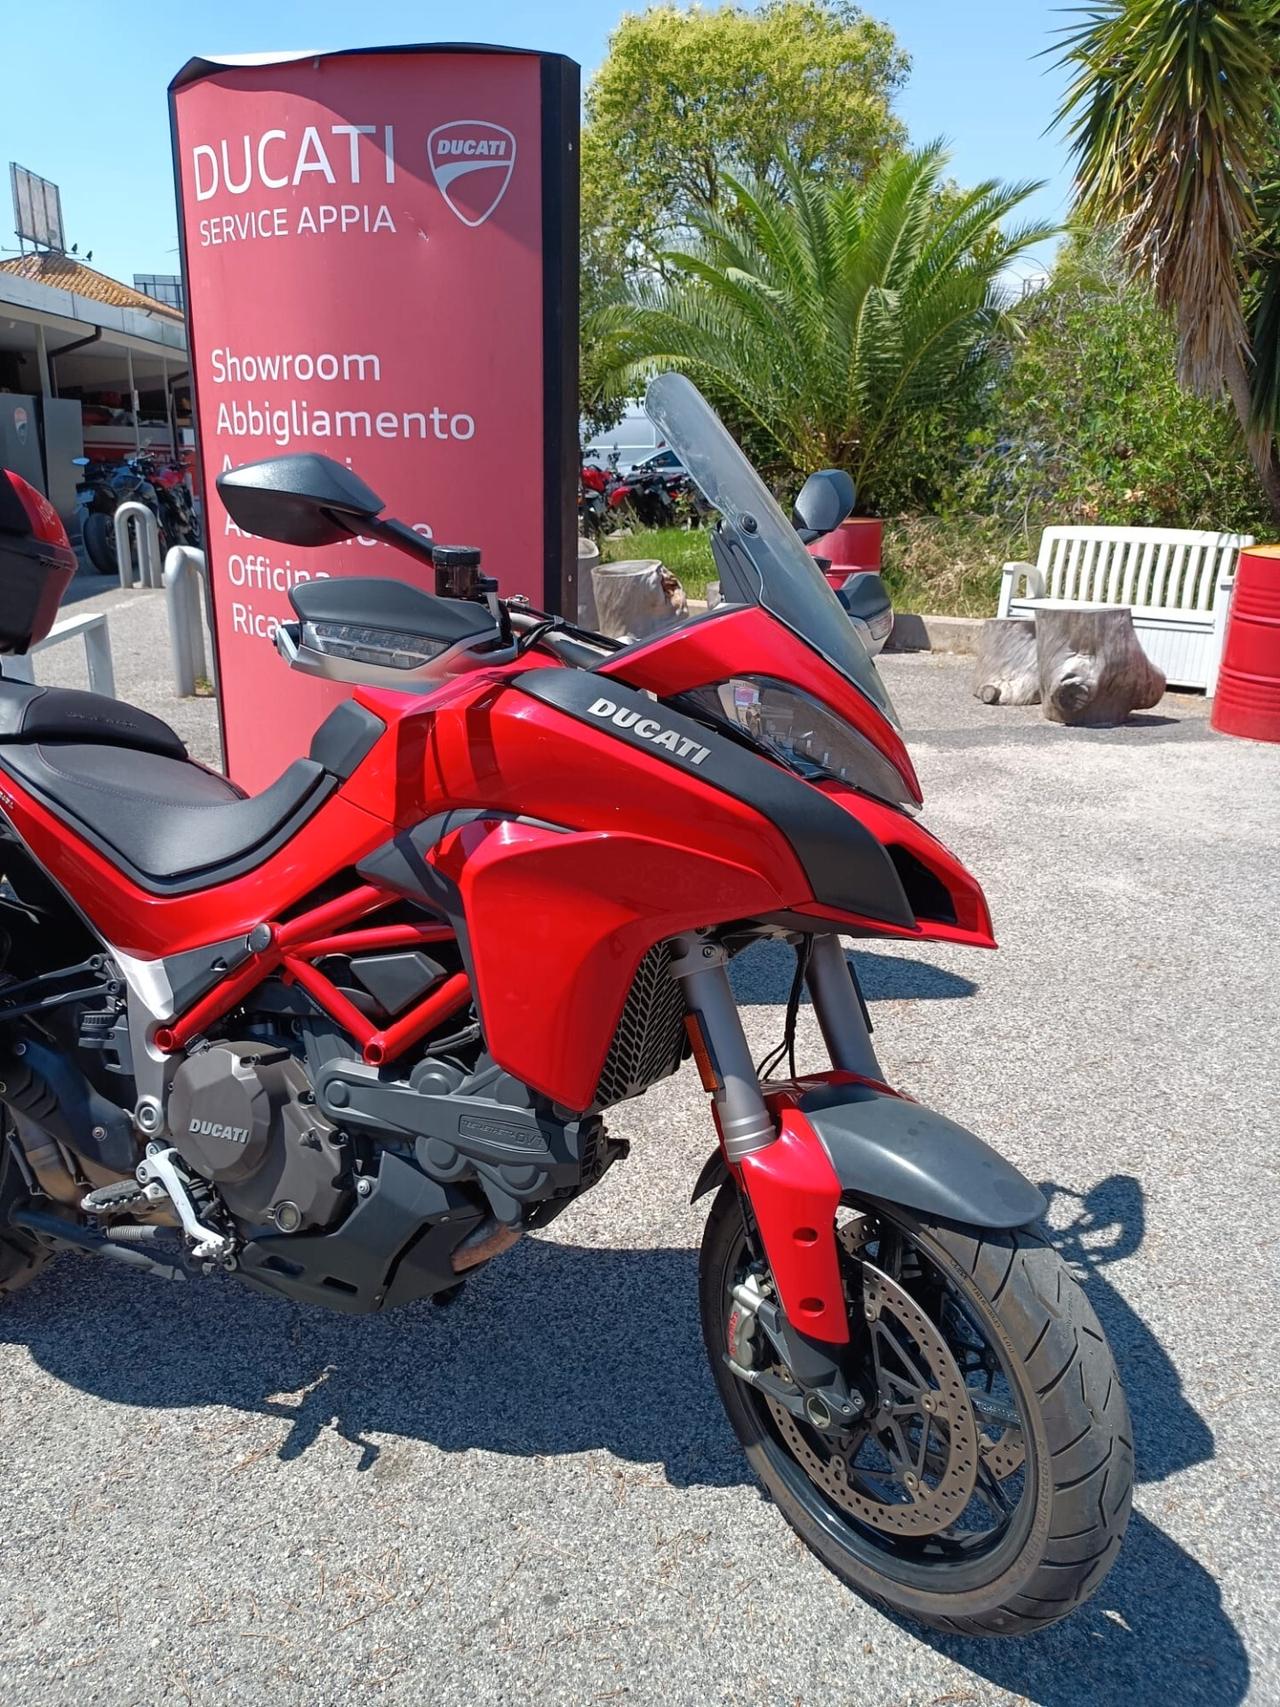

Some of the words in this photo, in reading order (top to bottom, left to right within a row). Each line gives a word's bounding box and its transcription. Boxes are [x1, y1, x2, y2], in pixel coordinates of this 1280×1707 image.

[193, 124, 395, 201] DUCATI
[437, 139, 506, 156] DUCATI
[200, 208, 288, 247] SERVICE
[297, 205, 396, 234] APPIA
[211, 347, 381, 383] Showroom
[216, 400, 476, 446] Abbigliamento
[228, 554, 331, 592] Officin
[587, 697, 712, 765] DUCATI
[189, 1118, 249, 1144] DUCATI
